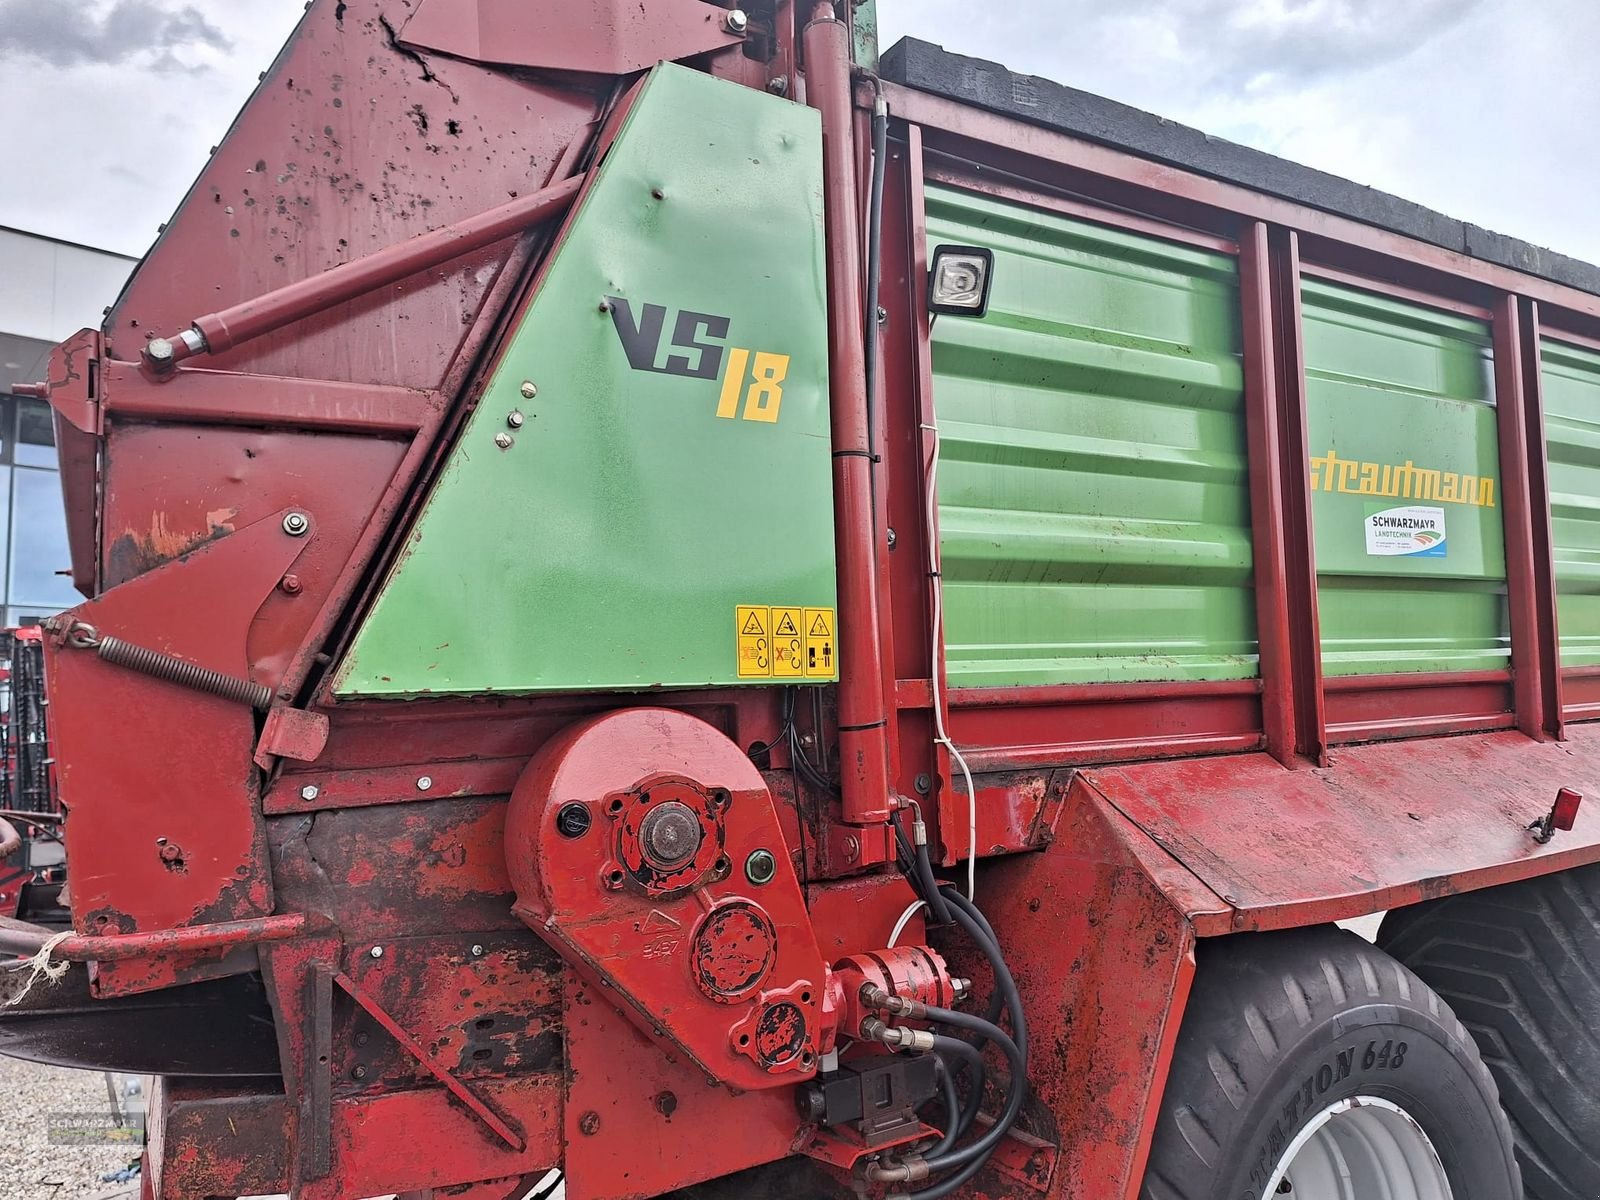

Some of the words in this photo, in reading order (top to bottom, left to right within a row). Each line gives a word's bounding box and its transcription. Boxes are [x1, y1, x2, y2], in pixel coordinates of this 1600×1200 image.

[603, 295, 731, 380] VS
[716, 347, 790, 423] 18
[1372, 516, 1435, 529] SCHWARZMAYR
[1361, 1039, 1408, 1070] 648
